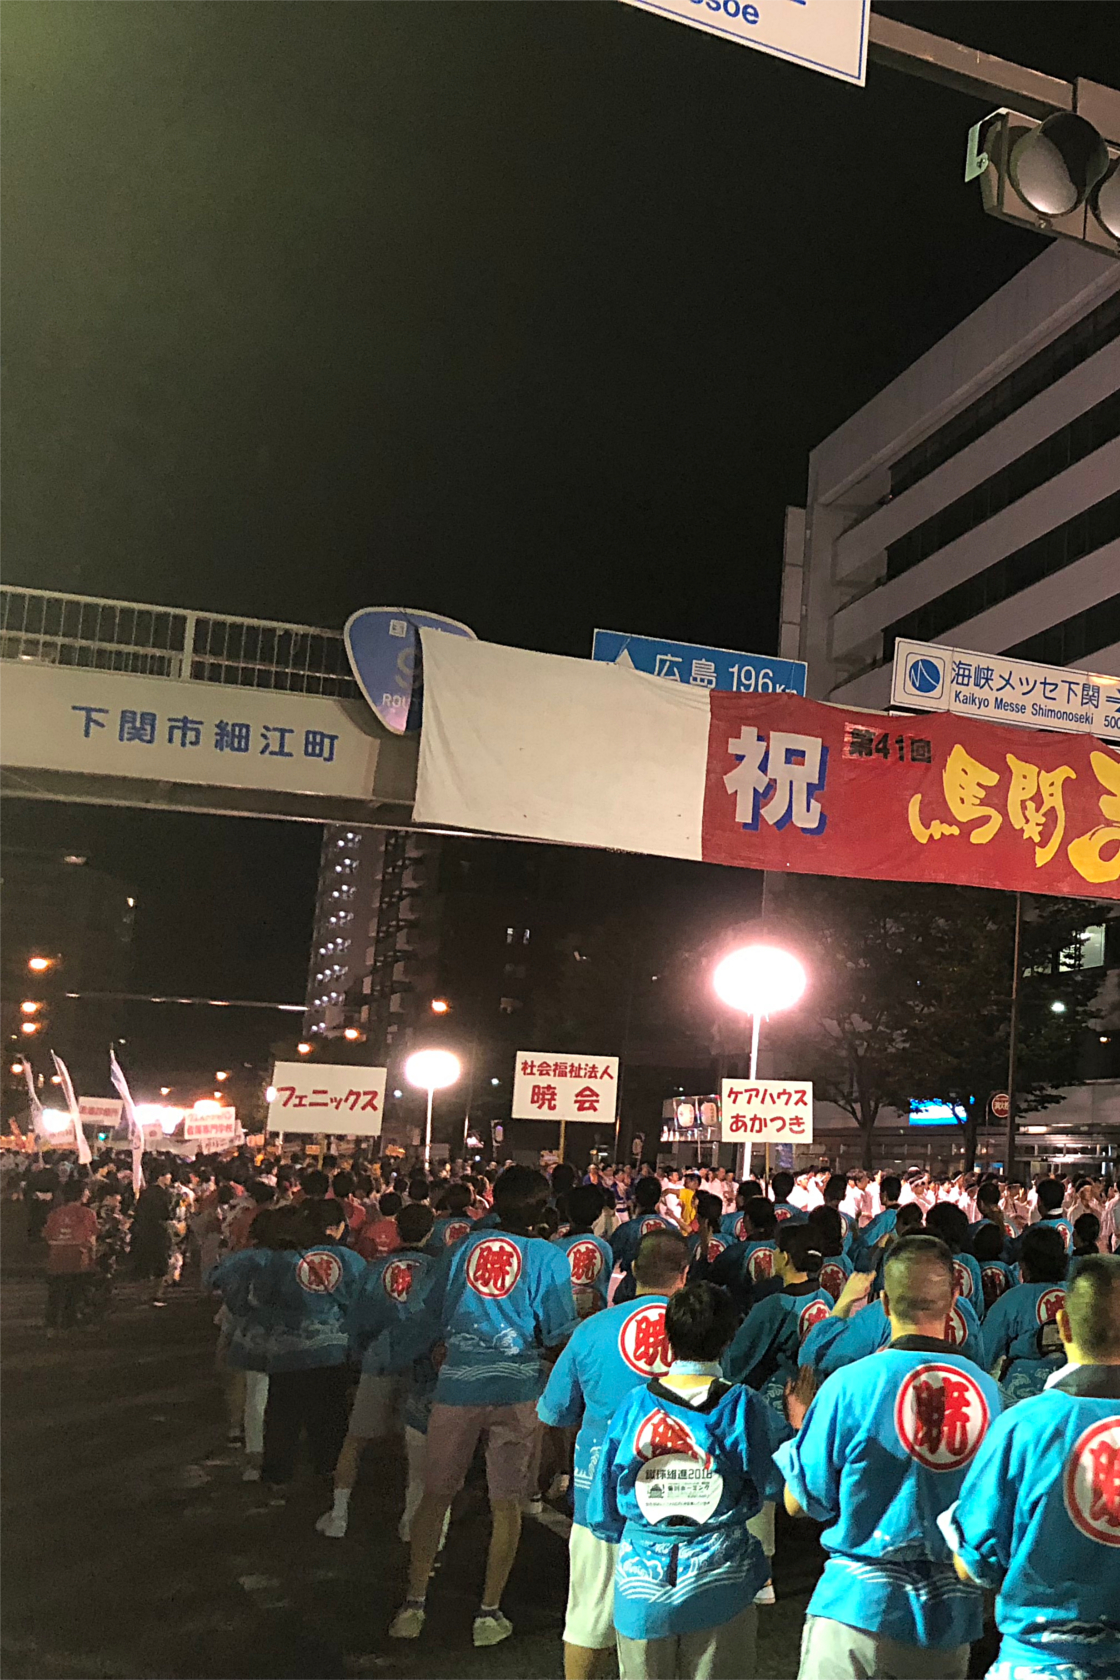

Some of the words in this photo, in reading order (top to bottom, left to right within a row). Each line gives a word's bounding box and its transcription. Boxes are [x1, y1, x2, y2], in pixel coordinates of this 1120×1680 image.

[690, 0, 760, 26] soe
[653, 653, 717, 689] 広島
[950, 660, 1100, 709] 海峡メッセ下関
[954, 690, 990, 709] Kaikyo
[994, 696, 1026, 715] Messe
[1031, 702, 1094, 726] Shimonoseki
[71, 704, 340, 763] 下関市細江町
[848, 726, 934, 766] 第41回
[723, 725, 829, 836] 祝
[520, 1059, 615, 1081] 社会福祉法人
[276, 1085, 380, 1113] フェニックス
[727, 1086, 809, 1108] ケアハウス
[728, 1113, 808, 1136] あかつき
